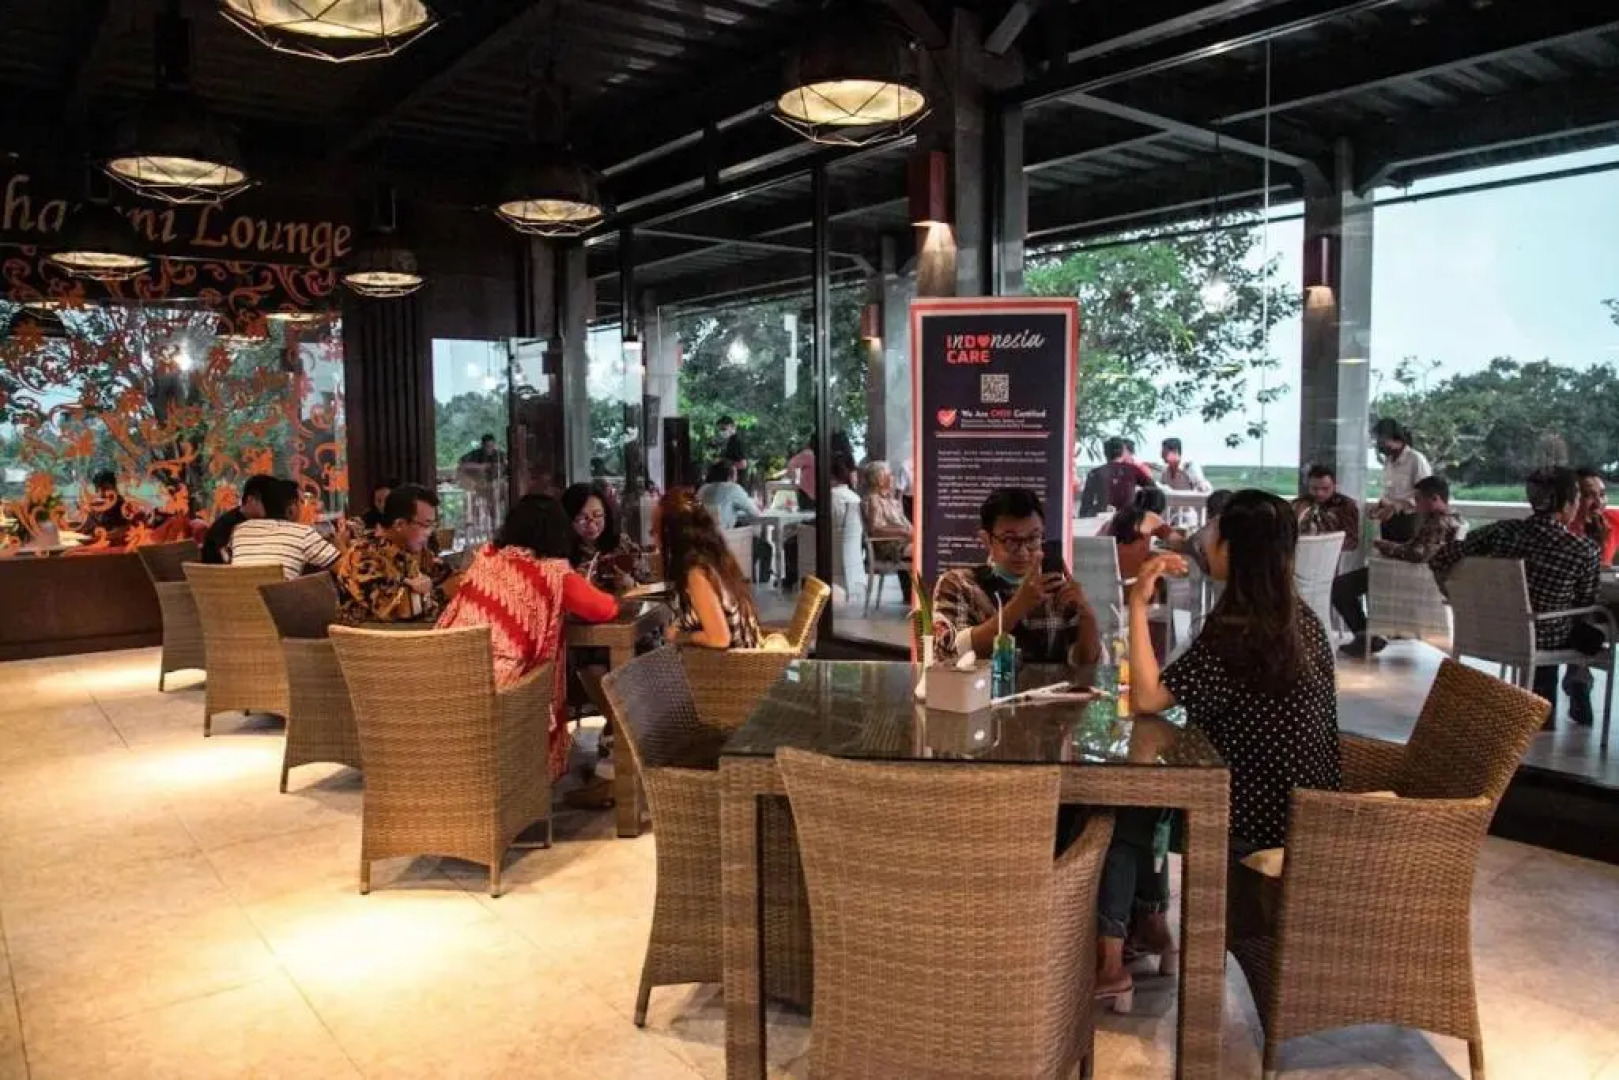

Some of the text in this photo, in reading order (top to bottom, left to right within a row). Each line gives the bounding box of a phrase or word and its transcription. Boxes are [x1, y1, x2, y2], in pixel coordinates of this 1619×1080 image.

[190, 202, 352, 267] Lounge
[946, 350, 991, 364] CARE
[961, 410, 973, 418] We
[975, 410, 989, 418] Are
